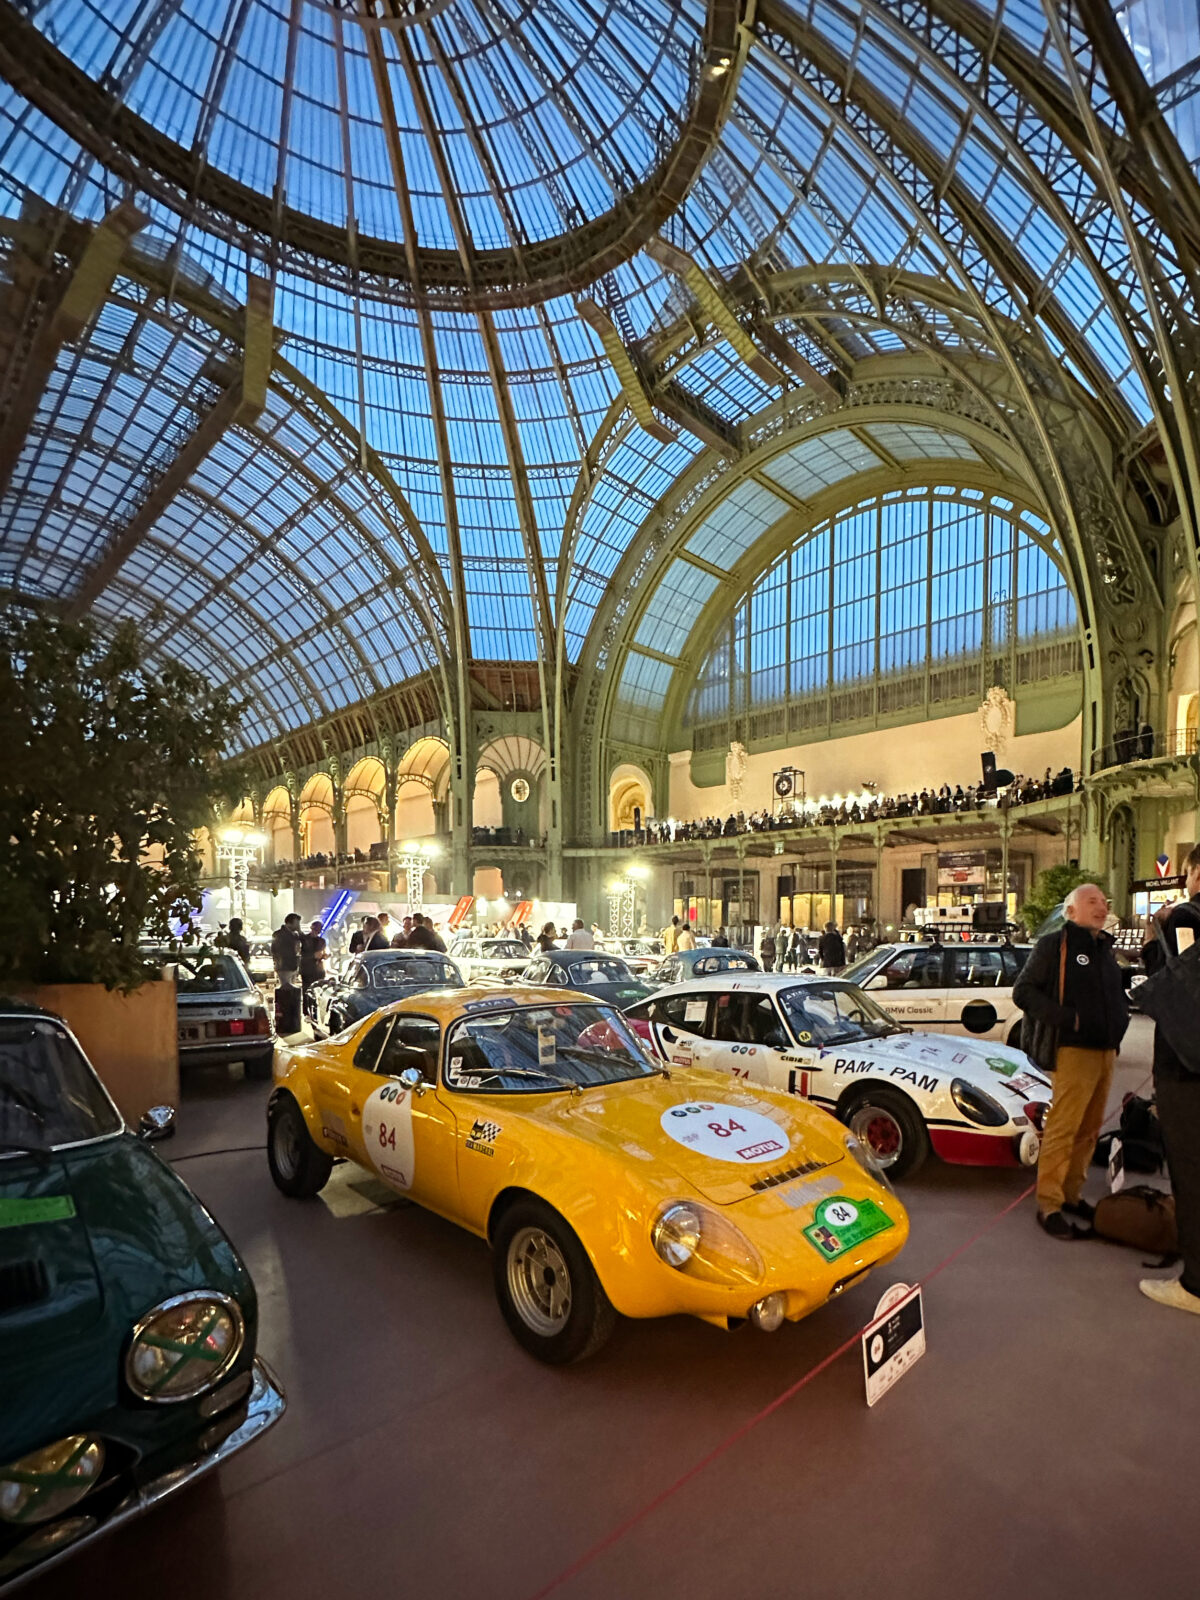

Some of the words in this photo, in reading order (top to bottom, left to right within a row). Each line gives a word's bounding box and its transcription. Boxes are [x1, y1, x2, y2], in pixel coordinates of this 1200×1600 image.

[885, 1006, 905, 1014] BMW
[907, 1006, 934, 1014] Classic
[834, 1059, 875, 1075] PAM
[890, 1066, 939, 1093] PAM
[379, 1122, 397, 1152] 84
[707, 1118, 748, 1138] 84
[740, 1140, 781, 1159] MOTUL
[831, 1205, 852, 1222] 84
